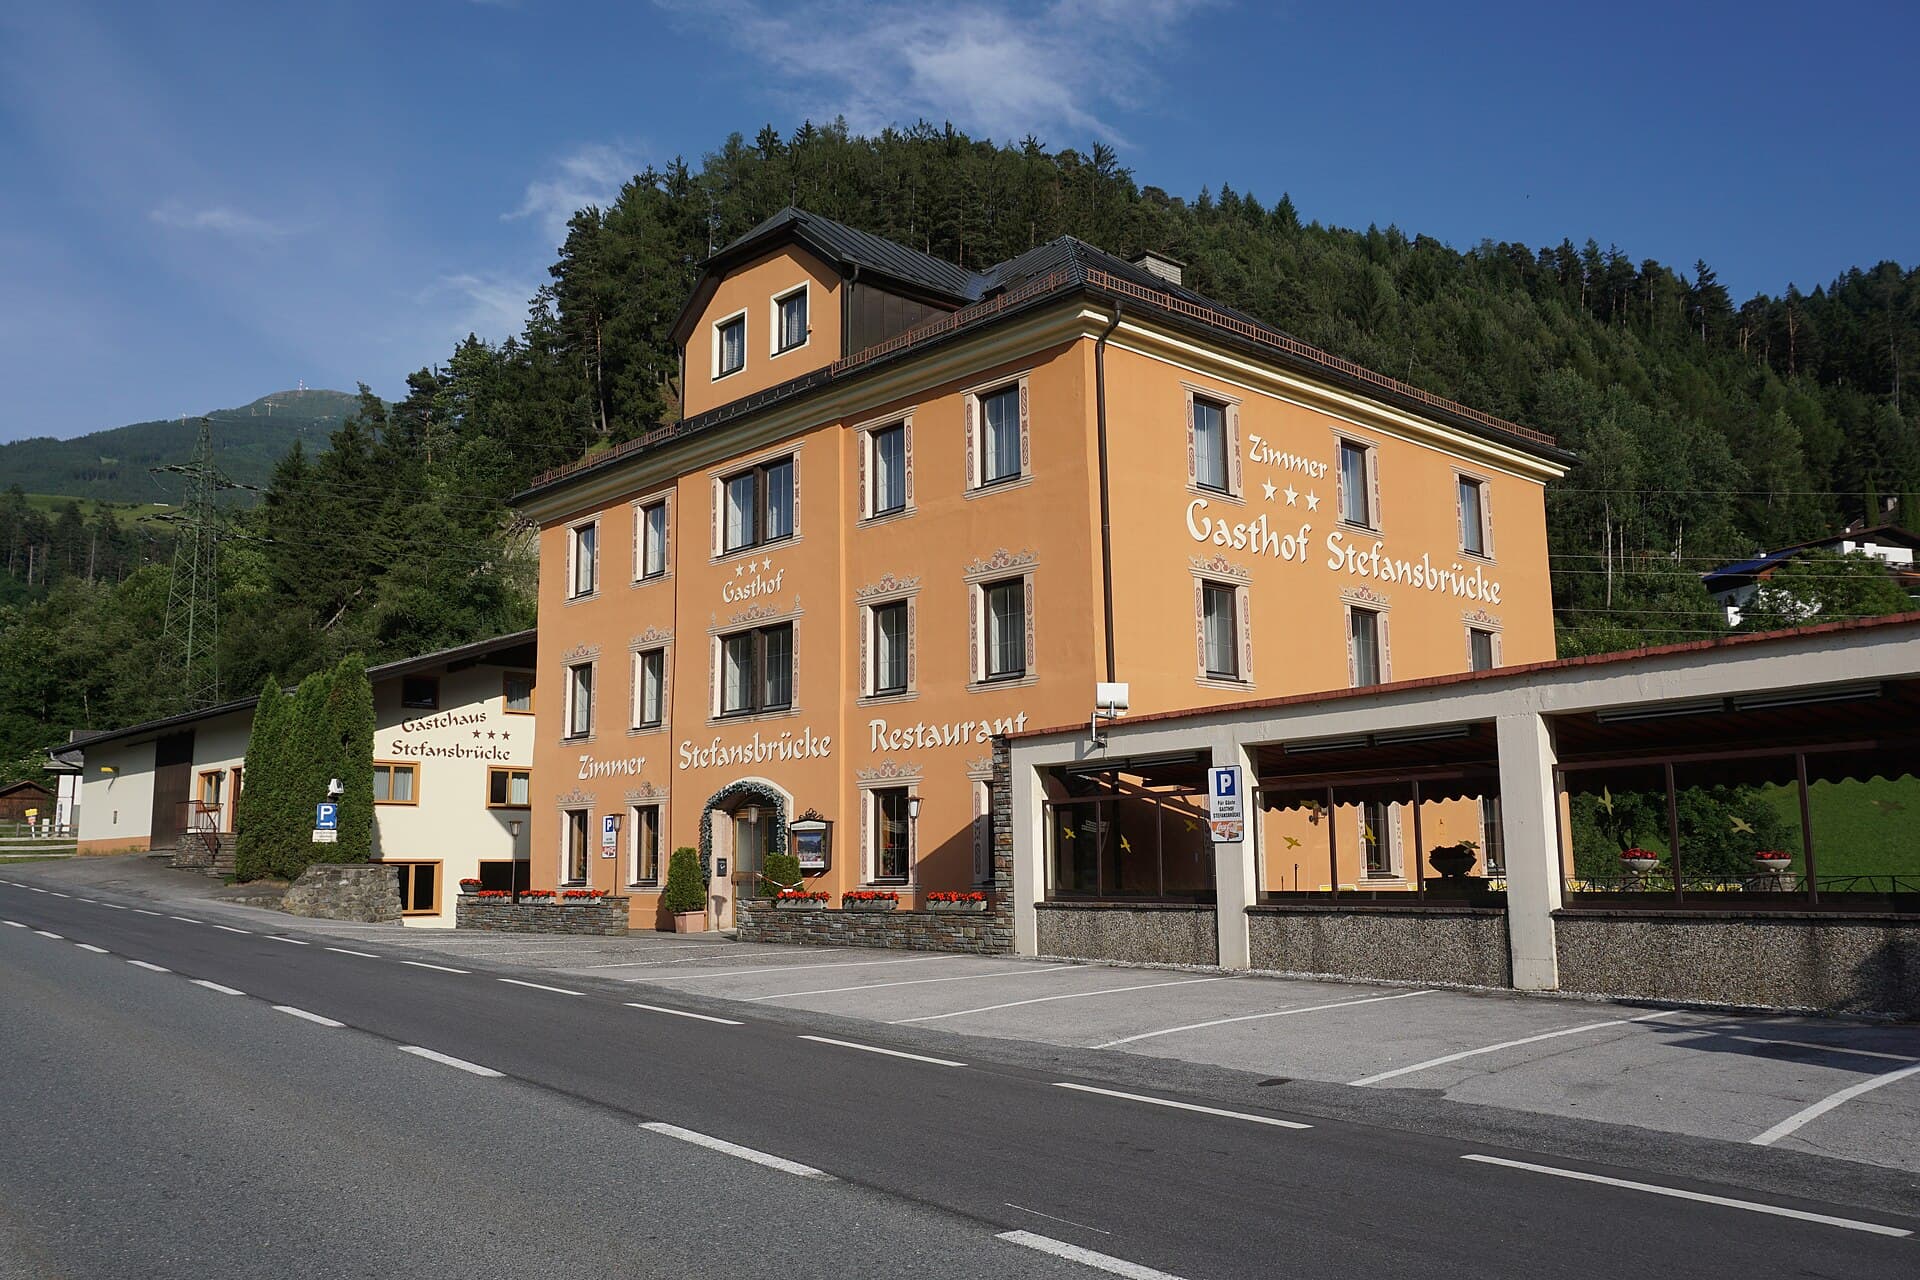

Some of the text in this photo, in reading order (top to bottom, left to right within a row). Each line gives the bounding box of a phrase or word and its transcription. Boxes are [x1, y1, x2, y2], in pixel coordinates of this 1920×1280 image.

[1248, 433, 1328, 479] Zimmer
[1186, 498, 1502, 605] Gasthof Stefansbrücke
[722, 568, 785, 604] Gasthof
[401, 711, 487, 733] Gästehaus
[868, 711, 1028, 753] Restaurant
[391, 739, 511, 760] Stefansbrücke
[679, 726, 832, 770] Stefansbrücke
[578, 755, 647, 780] Zimmer
[1220, 774, 1232, 794] P
[320, 805, 334, 821] P
[606, 819, 613, 831] P
